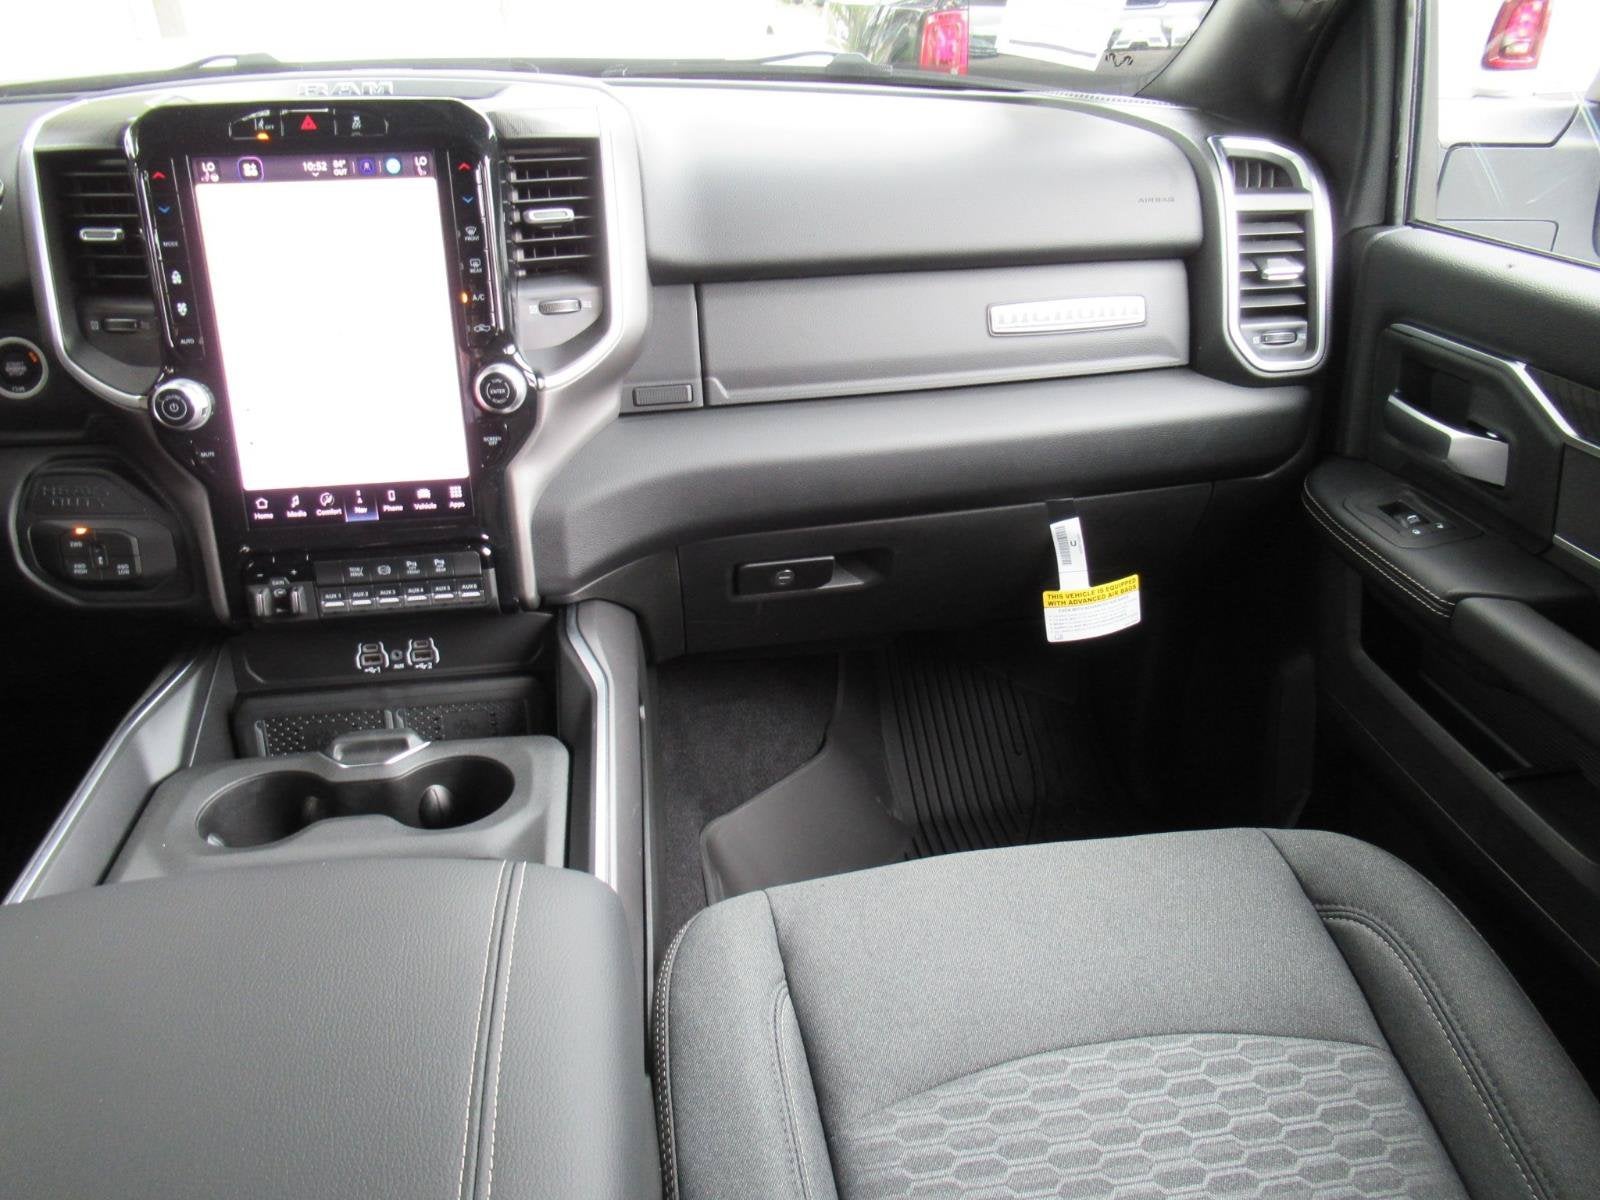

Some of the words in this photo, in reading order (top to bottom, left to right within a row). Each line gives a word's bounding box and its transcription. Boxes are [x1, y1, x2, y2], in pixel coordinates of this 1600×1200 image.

[298, 81, 394, 97] RAM
[302, 161, 328, 172] 10:52
[414, 156, 427, 166] LO
[472, 293, 485, 301] A/C
[254, 512, 274, 520] Home
[286, 510, 307, 518] Media
[316, 508, 342, 516] Comfort
[354, 506, 368, 514] Nav
[413, 502, 437, 510] Vehicle
[449, 501, 465, 510] Apps
[1066, 590, 1097, 599] VEHICLE
[1106, 577, 1137, 592] EQUIPPED
[1069, 594, 1107, 605] ADVANCED
[1121, 585, 1137, 594] BAGS
